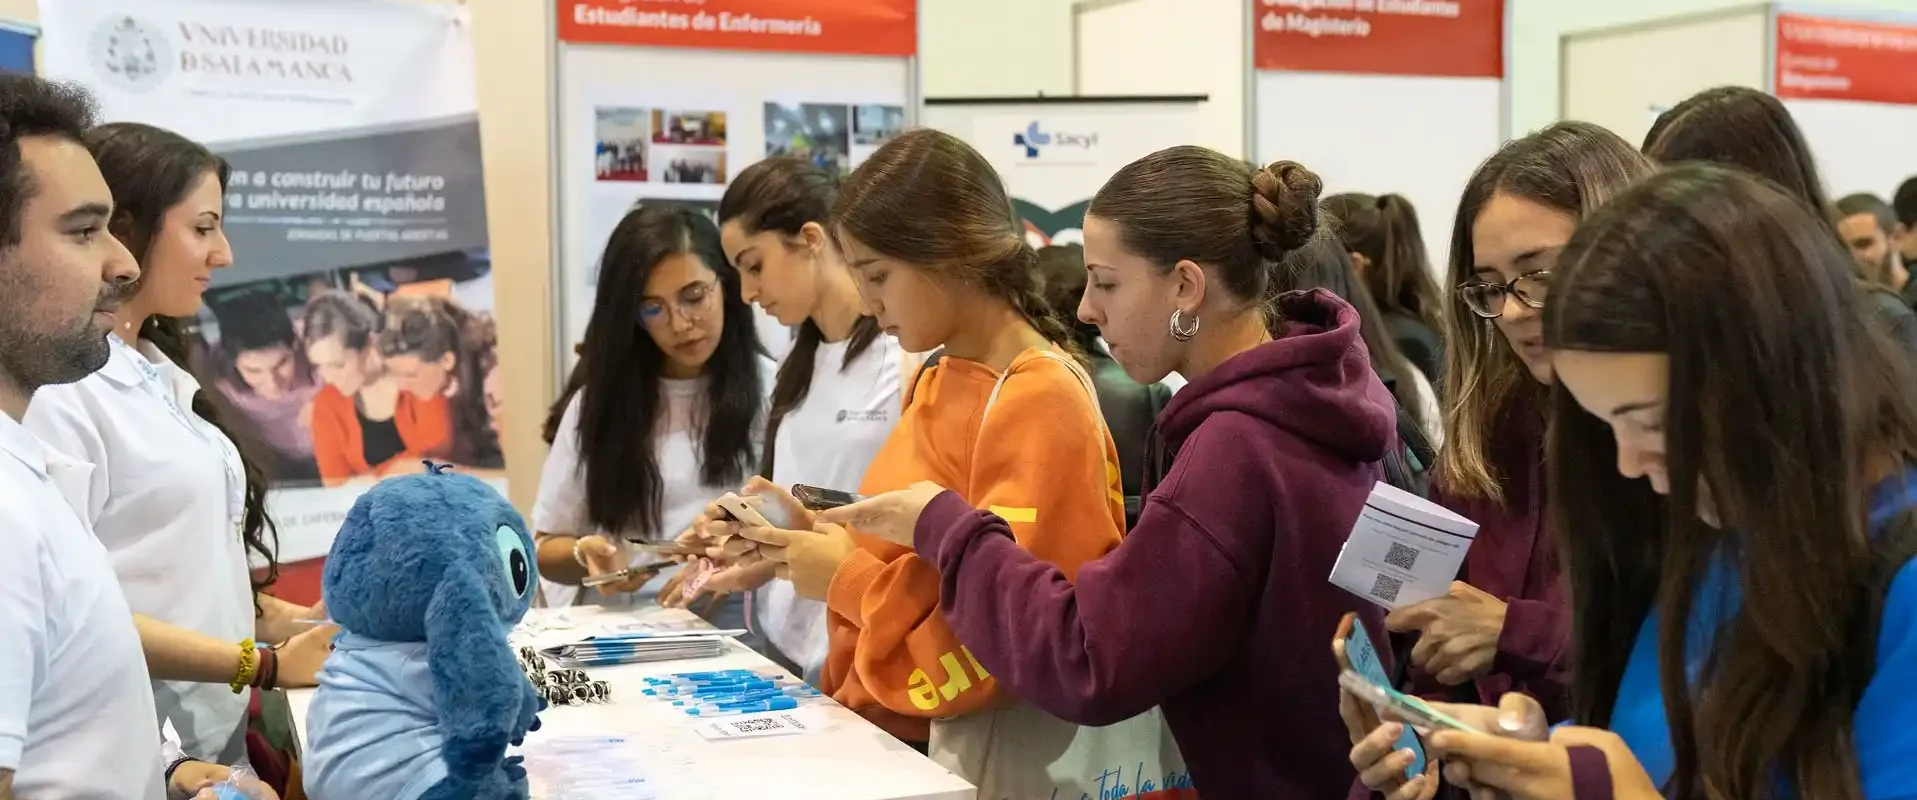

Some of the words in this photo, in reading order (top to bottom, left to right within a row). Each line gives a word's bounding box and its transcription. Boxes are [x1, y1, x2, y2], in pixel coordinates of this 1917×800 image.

[574, 4, 689, 29] Estudiantes
[692, 10, 716, 30] de
[1377, 0, 1460, 18] Estudiantes
[1261, 11, 1284, 31] de
[1286, 12, 1371, 38] Magisterio
[1055, 132, 1098, 149] Sacyl
[252, 171, 266, 187] a
[271, 169, 356, 189] construir
[361, 173, 382, 190] tu
[384, 171, 445, 193] futuro
[247, 190, 359, 211] universidad
[362, 194, 445, 214] española
